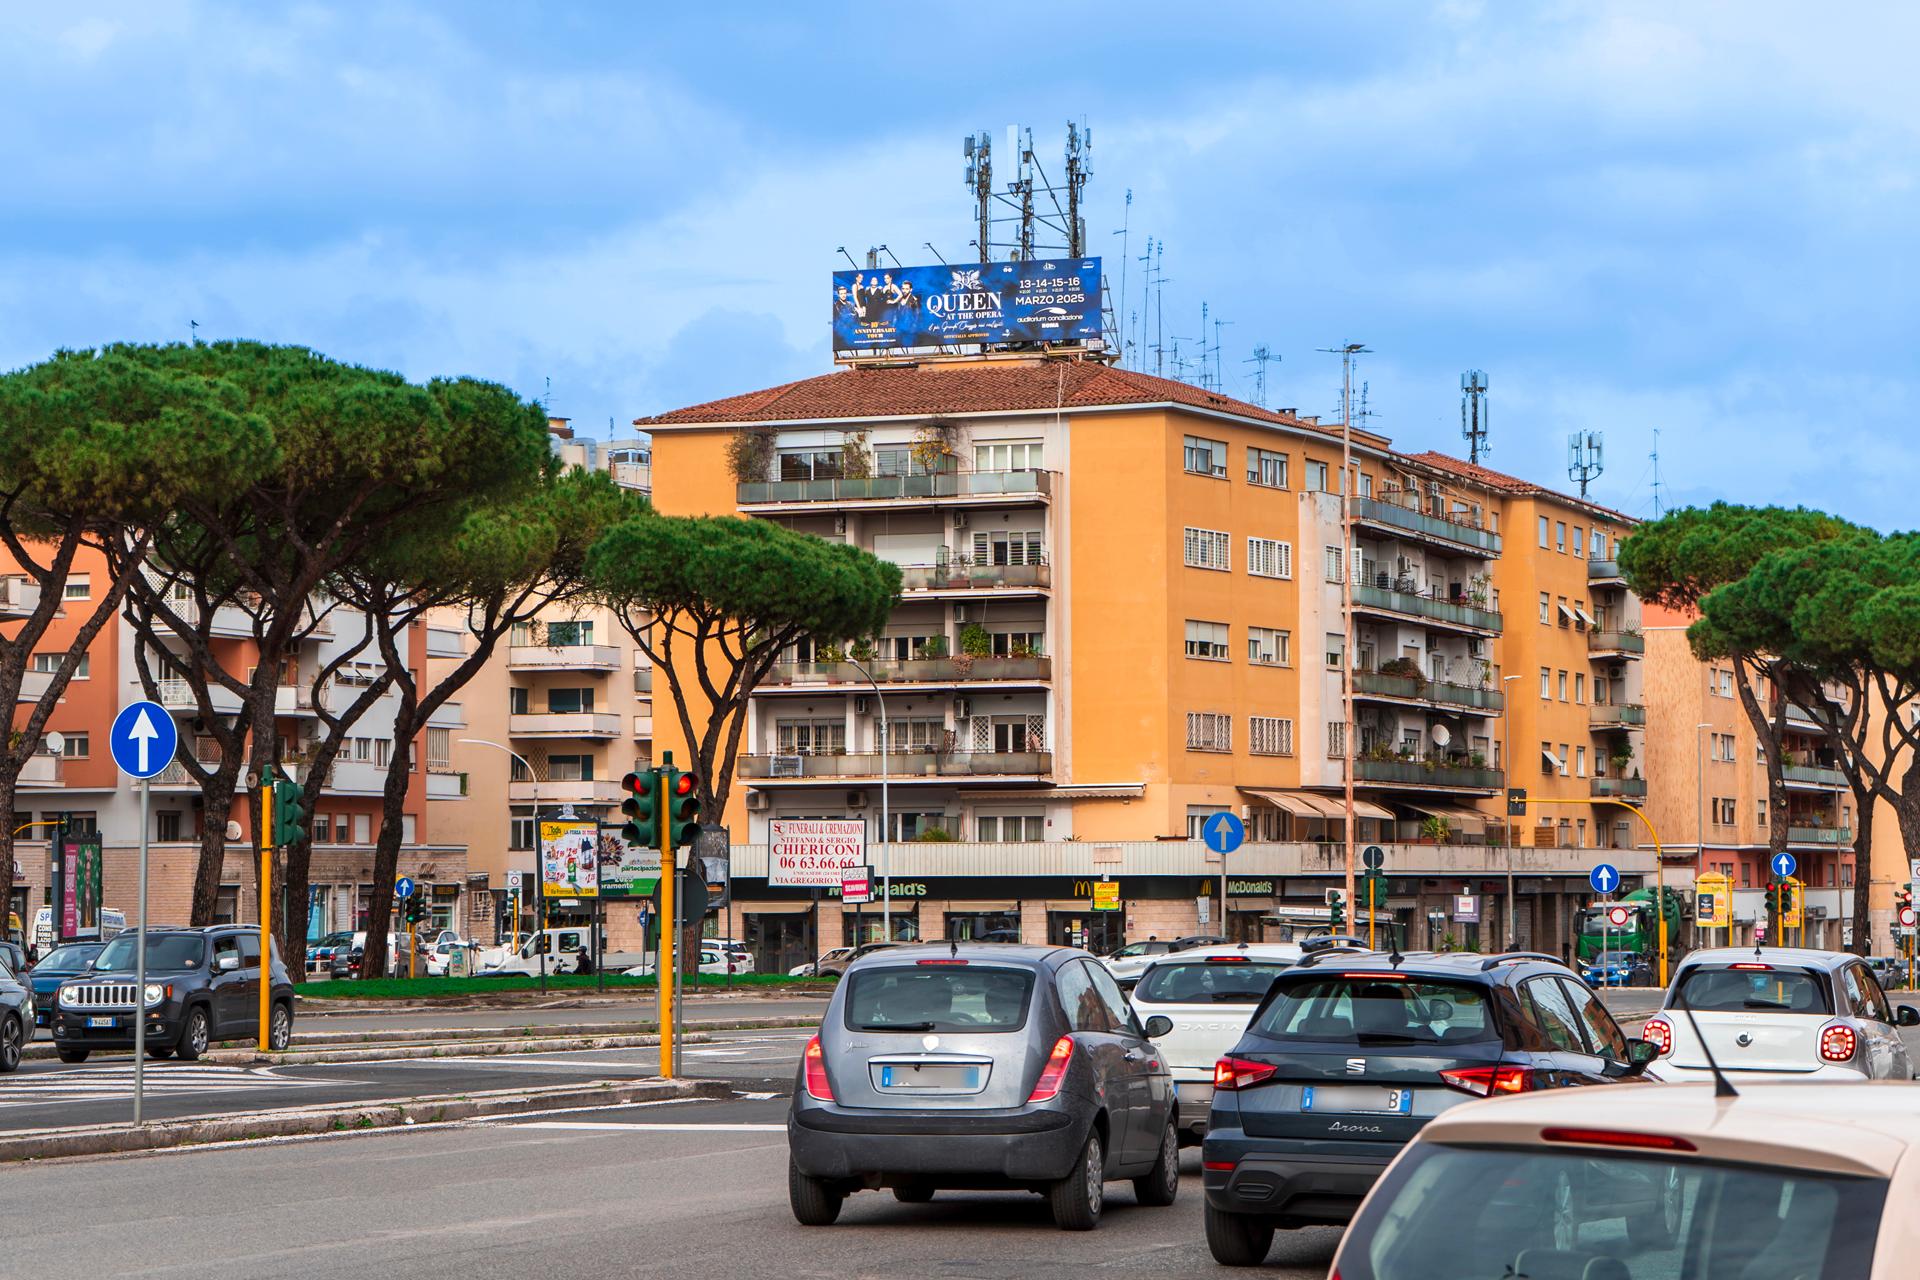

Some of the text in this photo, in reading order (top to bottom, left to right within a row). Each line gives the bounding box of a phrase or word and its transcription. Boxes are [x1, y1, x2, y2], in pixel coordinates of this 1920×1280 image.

[926, 292, 1002, 318] QUEEN
[1015, 294, 1085, 305] MARZO 2025
[957, 312, 974, 320] THE
[975, 311, 1002, 319] OPERA
[788, 823, 818, 834] FUNERALI
[825, 823, 863, 834] CREMAZIONI
[780, 836, 817, 844] STEFANO
[826, 836, 856, 844] SERGIO
[773, 843, 860, 855] CHIERICONI
[780, 856, 855, 869] 06 63.66.66
[1227, 881, 1272, 894] McDonald's
[1180, 1023, 1242, 1032] DACIA
[1327, 1121, 1383, 1133] Arona
